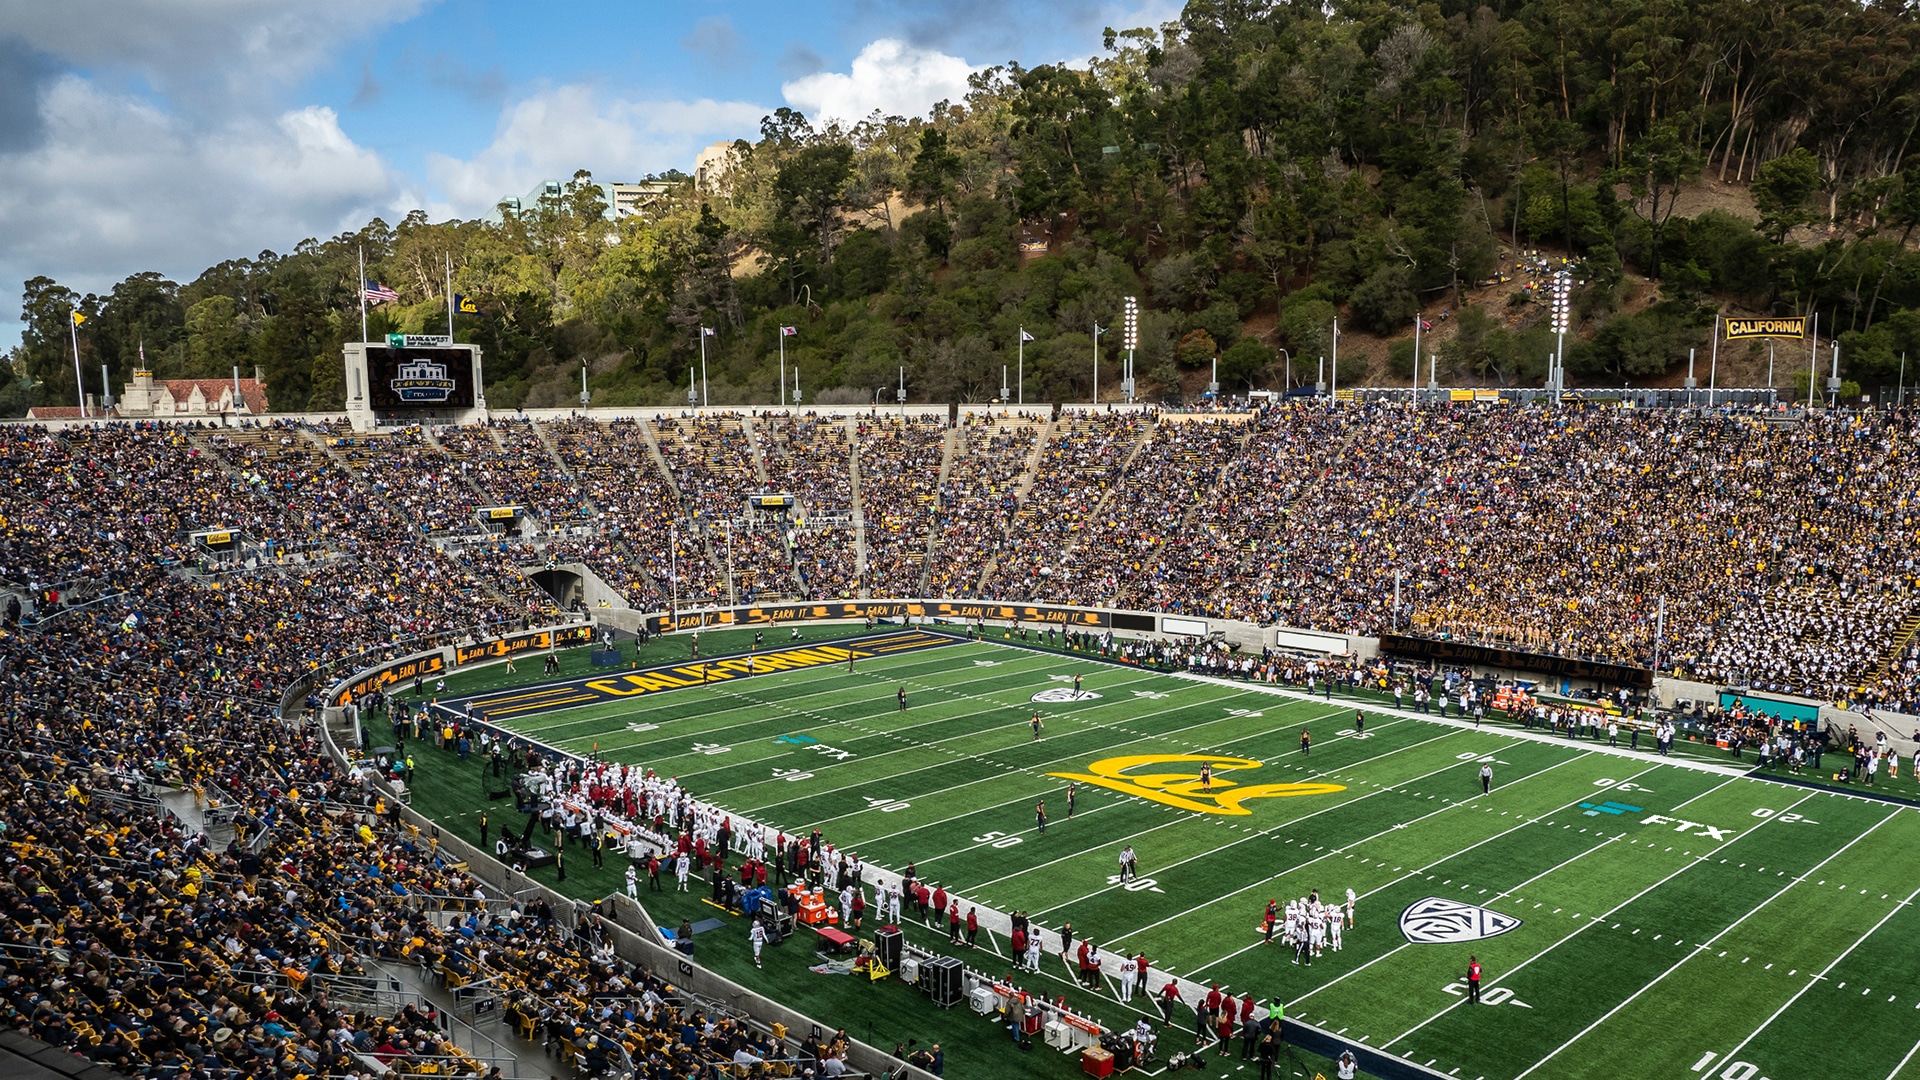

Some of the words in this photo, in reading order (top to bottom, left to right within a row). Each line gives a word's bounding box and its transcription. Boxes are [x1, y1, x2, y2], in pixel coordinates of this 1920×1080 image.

[460, 297, 478, 313] Cal
[1729, 320, 1802, 335] CALIFORNIA
[772, 610, 795, 621] EARN
[798, 608, 808, 619] IT
[867, 606, 890, 616] EARN
[892, 605, 901, 615] IT
[961, 606, 983, 617] EARN
[986, 607, 995, 617] IT
[1047, 611, 1067, 622] EARN
[1070, 612, 1080, 623] IT
[679, 616, 702, 628] EARN
[704, 614, 714, 625] IT
[512, 639, 528, 650] EARN
[530, 637, 537, 647] IT
[1397, 639, 1421, 651] EARN
[1424, 642, 1435, 651] IT
[469, 646, 486, 660] EARN
[487, 644, 494, 657] IT
[1455, 648, 1478, 660] EARN
[1481, 650, 1492, 662] IT
[400, 664, 416, 680] EARN
[419, 660, 426, 673] IT
[585, 645, 875, 696] CALIFORNIA
[1527, 657, 1551, 670] EARN
[1557, 660, 1569, 672] IT
[1592, 666, 1619, 680] EARN
[1624, 670, 1637, 683] IT
[691, 743, 732, 755] 20
[801, 743, 858, 761] FTX
[1455, 751, 1497, 763] 40
[772, 768, 815, 782] 30
[1045, 754, 1348, 816] Cal
[1592, 778, 1640, 793] 30
[867, 798, 911, 813] 40
[1751, 807, 1804, 824] 20
[1639, 814, 1737, 842] FTX
[972, 830, 1024, 849] 50
[1030, 938, 1039, 946] 77
[680, 962, 691, 974] GG
[1441, 977, 1516, 1006] 20
[813, 1026, 820, 1037] H
[1690, 1050, 1760, 1080] 10
